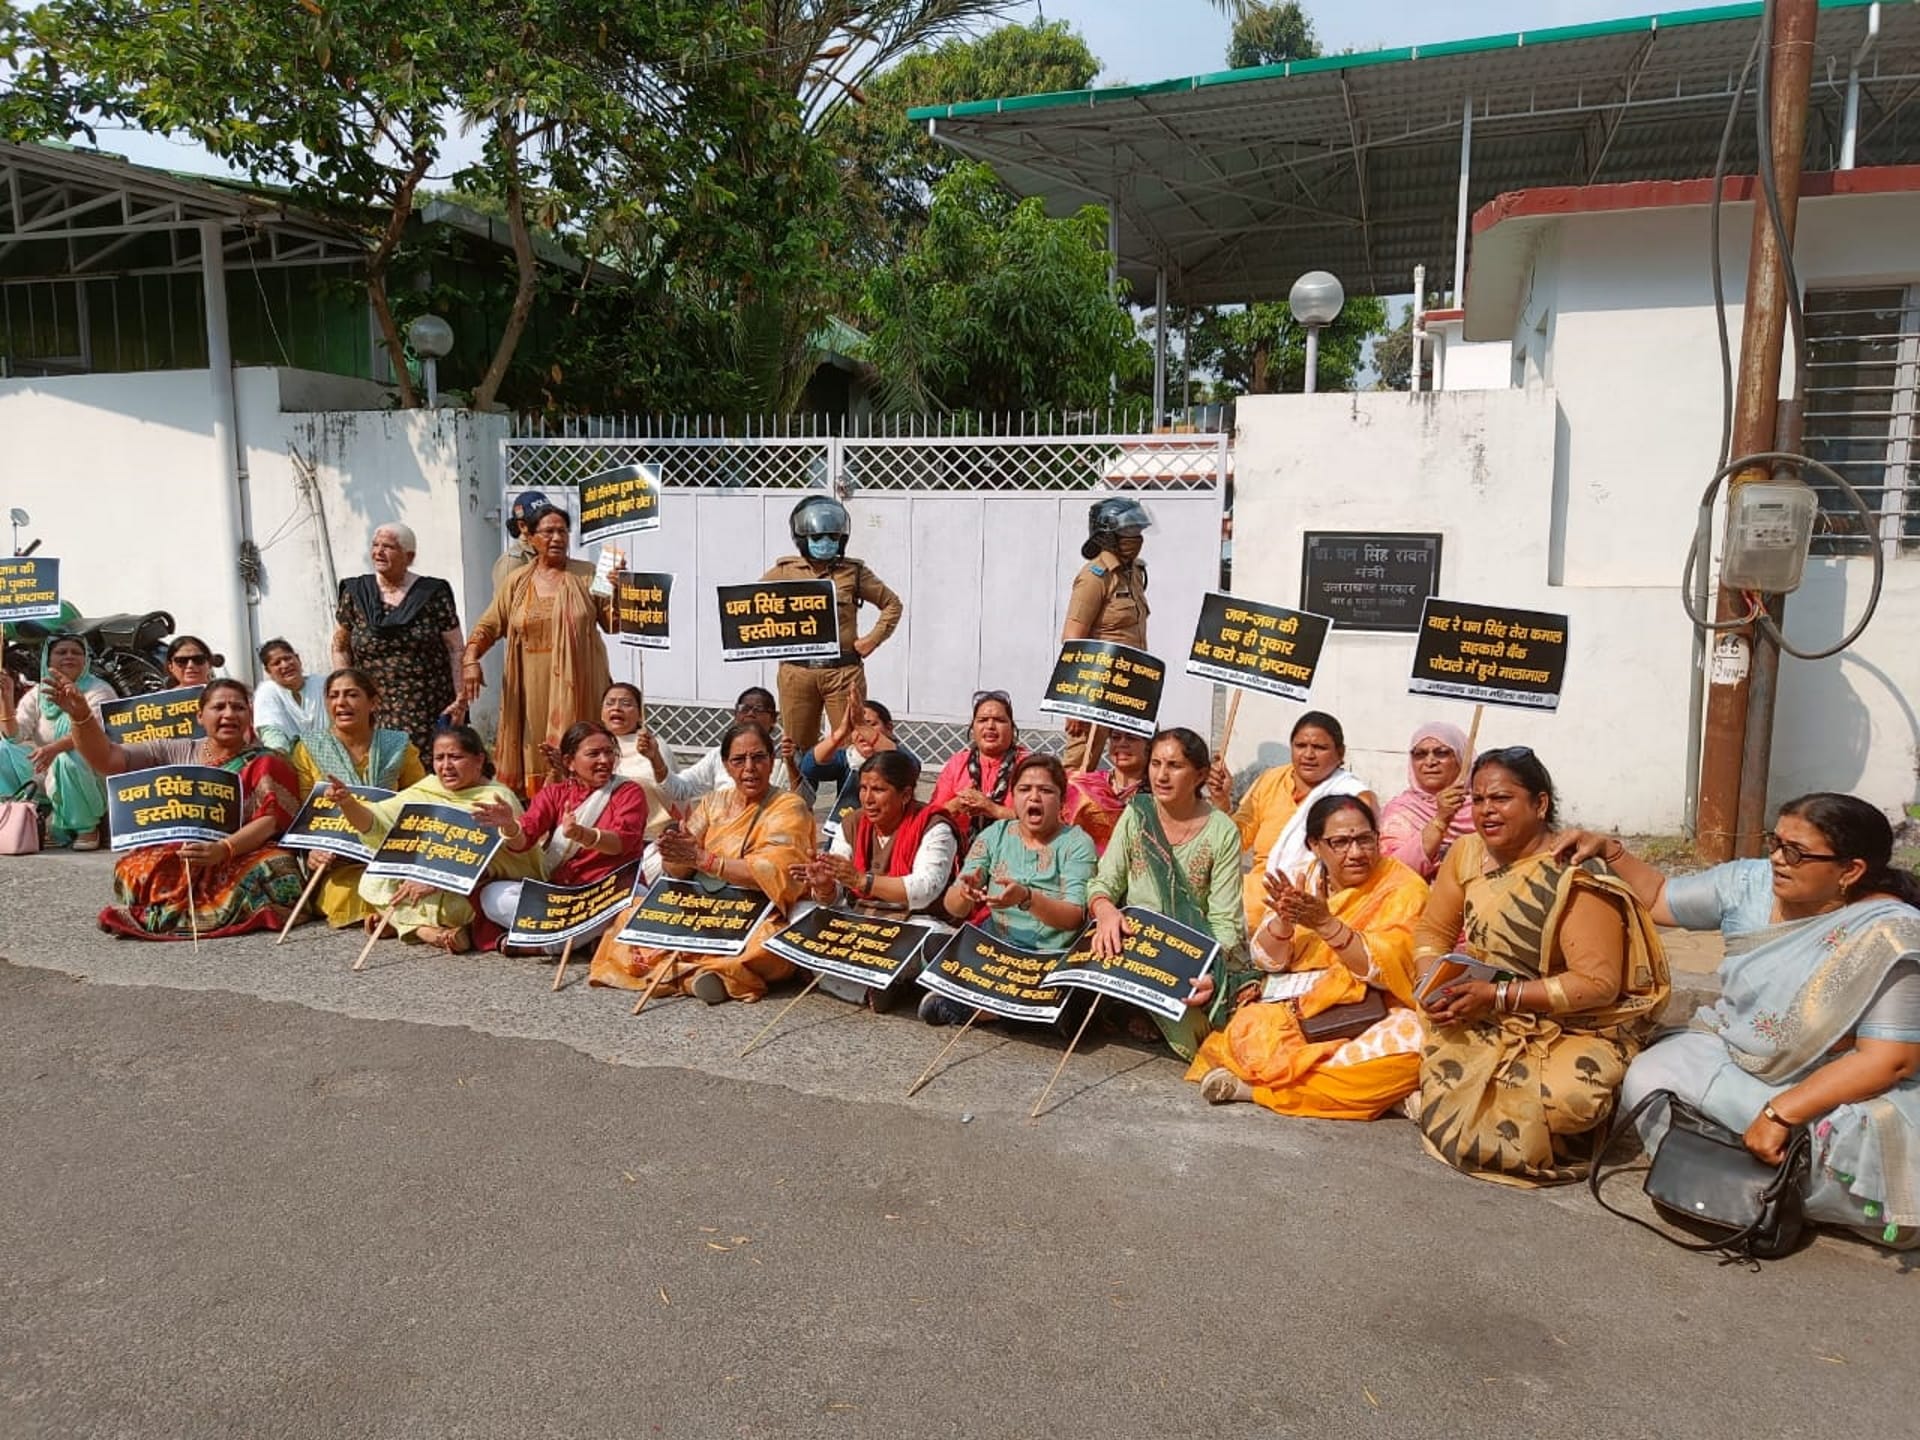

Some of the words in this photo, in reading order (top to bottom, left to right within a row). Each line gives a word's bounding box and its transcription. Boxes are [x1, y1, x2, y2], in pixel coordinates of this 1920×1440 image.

[1364, 544, 1390, 562] सिंह
[1396, 550, 1429, 563] रावत
[8, 578, 37, 593] पुकार
[726, 600, 751, 615] धन
[754, 592, 786, 614] सिंह
[789, 595, 827, 612] रावत
[738, 617, 796, 642] इस्तीफा
[800, 615, 818, 635] दो
[1225, 608, 1278, 630] जन-जन
[1279, 617, 1298, 635] की
[1428, 616, 1450, 631] वाह
[1452, 615, 1461, 631] रे
[1484, 619, 1506, 639] सिंह
[1509, 623, 1528, 640] तेरा
[1530, 629, 1563, 643] कमाल
[1221, 627, 1242, 642] एक
[1242, 628, 1258, 647] ही
[1258, 636, 1296, 655] पुकार
[1460, 640, 1505, 657] सहकारी
[1506, 644, 1528, 659] बैंक
[1194, 638, 1211, 656] बंद
[1212, 645, 1236, 662] करो
[1235, 652, 1259, 667] अब
[1260, 657, 1312, 680] भ्रष्टाचार
[1429, 654, 1463, 672] घोटाले
[1466, 658, 1479, 673] में
[1478, 661, 1497, 681] हुये
[1498, 667, 1550, 683] मालामाल
[109, 711, 133, 726] धन
[135, 703, 163, 721] सिंह
[166, 699, 201, 716] रावत
[176, 718, 192, 735] दो
[118, 784, 150, 802] धन
[155, 775, 194, 797] सिंह
[198, 780, 234, 800] रावत
[133, 799, 205, 826] इस्तीफा
[208, 803, 225, 824] दो
[941, 960, 960, 975] की
